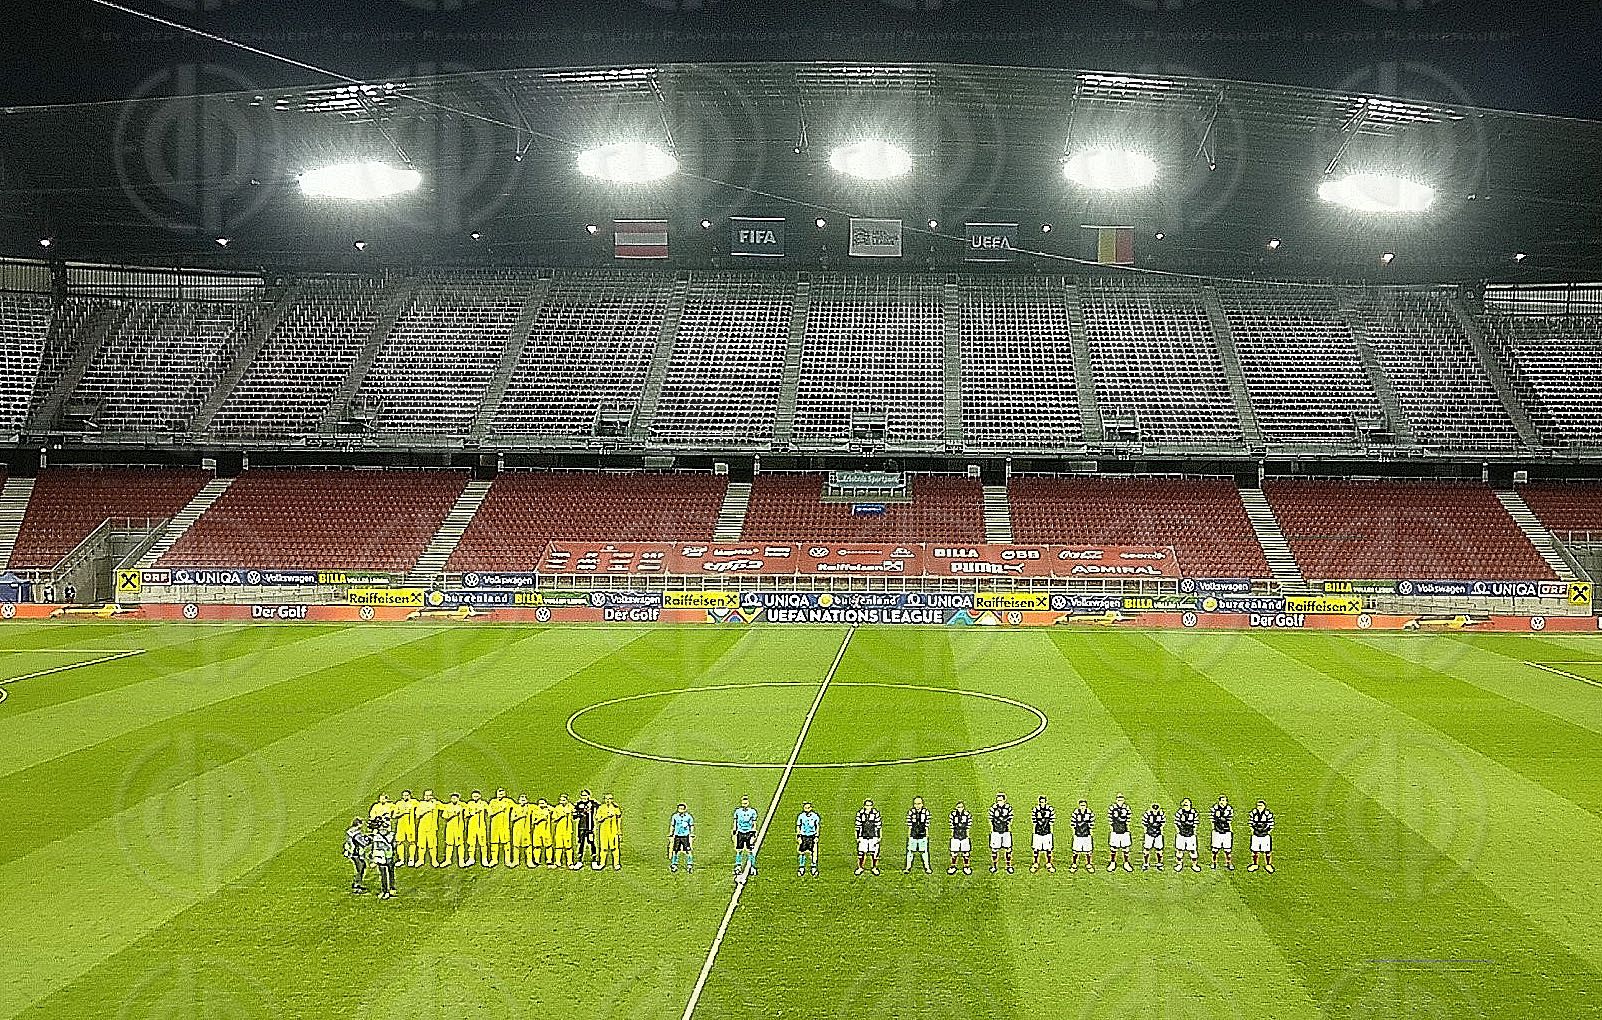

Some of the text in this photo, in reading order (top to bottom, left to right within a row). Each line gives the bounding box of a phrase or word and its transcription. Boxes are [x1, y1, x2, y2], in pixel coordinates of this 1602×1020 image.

[739, 229, 776, 244] FIFA
[971, 235, 1011, 250] UEFA
[1071, 565, 1162, 574] ADMIRAL
[143, 573, 169, 582] ORF
[195, 572, 241, 584] UNIQA
[264, 573, 316, 584] Volkswagen
[318, 573, 347, 584] BILLA
[482, 575, 532, 587] Volkswagen
[1199, 582, 1249, 593] Volkswagen
[1324, 582, 1352, 593] BILLA
[1416, 583, 1466, 595] Volkswagen
[1492, 583, 1536, 596] UNIQA
[1541, 585, 1567, 595] ORF
[349, 592, 410, 604] Raiffeisen
[443, 591, 508, 604] burgenland
[514, 593, 543, 604] BILLA
[611, 593, 661, 605] Volkswagen
[664, 593, 725, 607] Raiffeisen
[765, 595, 810, 607] UNIQA
[928, 596, 973, 608] UNIQA
[976, 597, 1035, 609] Raiffeisen
[1070, 597, 1121, 610] Volkswagen
[1123, 598, 1153, 609] BILLA
[252, 605, 307, 618] Der Golf
[1219, 599, 1282, 612] burgenland
[1287, 601, 1347, 613] Raiffeisen
[604, 608, 660, 621] Der Golf
[767, 609, 943, 623] UEFA NATIONS LEAGUE
[1250, 614, 1305, 627] Der Golf
